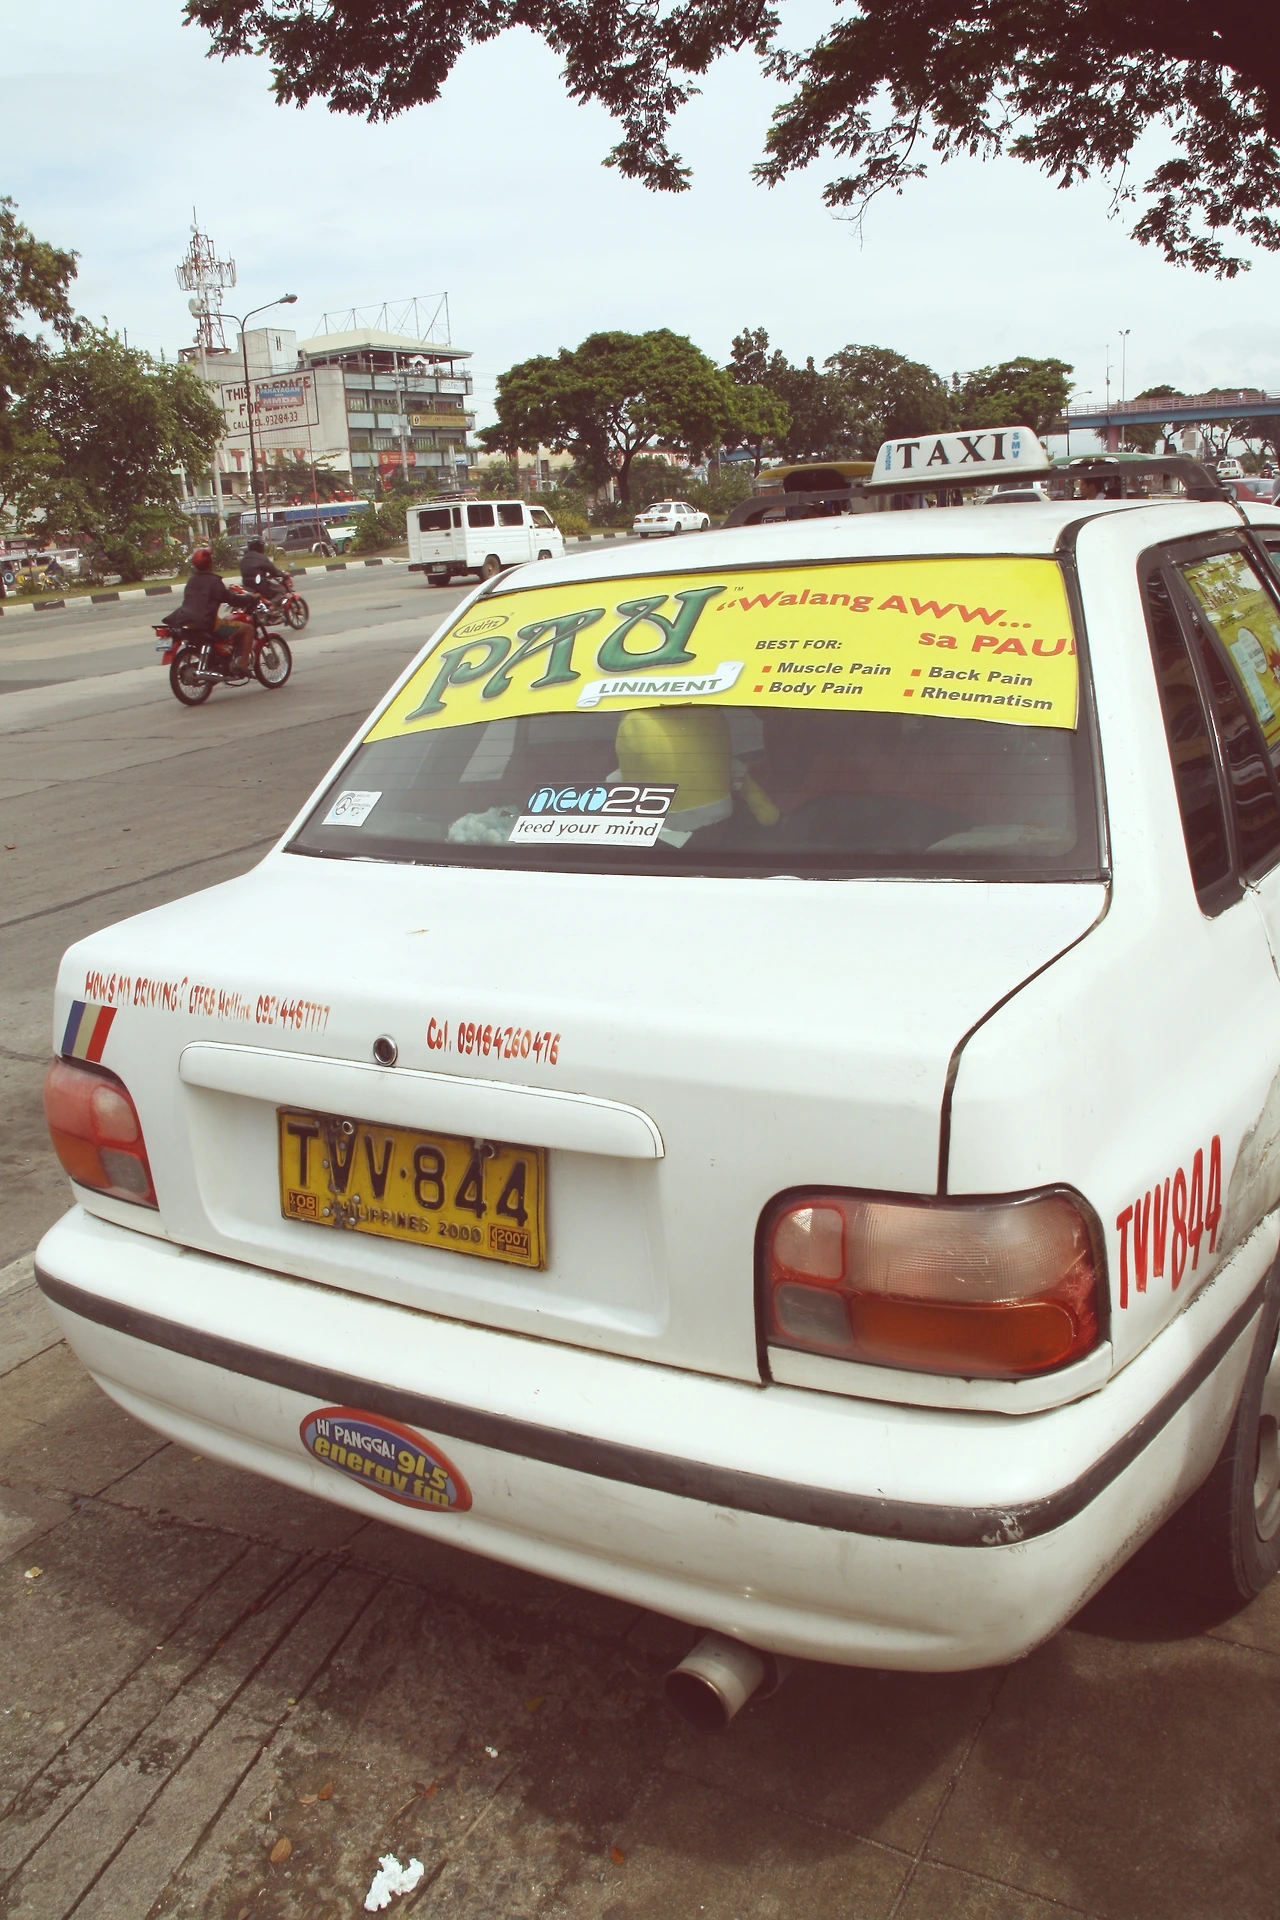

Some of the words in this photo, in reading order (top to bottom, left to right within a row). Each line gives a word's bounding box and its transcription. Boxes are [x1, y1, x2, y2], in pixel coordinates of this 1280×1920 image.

[226, 387, 250, 402] THIS
[263, 397, 299, 405] MMDA
[239, 401, 262, 417] FOR
[896, 432, 1008, 469] TAXI
[1011, 432, 1021, 459] SMV
[877, 595, 1032, 629] AWW...
[460, 619, 500, 636] Aldritz
[755, 640, 799, 650] BEST
[802, 639, 842, 650] FOR:
[918, 632, 958, 650] sa
[405, 586, 728, 721] PAU
[777, 662, 843, 674] Muscle
[849, 663, 892, 676] Pain
[928, 666, 981, 682] Back
[987, 671, 1033, 687] Pain
[599, 678, 722, 694] LINIMENT
[768, 682, 816, 696] Body
[821, 682, 863, 695] Pain
[920, 686, 1053, 711] Rheumatism
[527, 786, 675, 815] net25
[517, 820, 556, 834] feed
[556, 823, 601, 837] your
[604, 820, 659, 837] mind
[84, 970, 116, 1004] HOWS
[296, 1194, 316, 1210] 08
[437, 1219, 484, 1244] 2000
[1116, 1134, 1222, 1310] TVV844
[497, 1229, 528, 1247] 2007
[316, 1418, 330, 1437] HI
[334, 1425, 396, 1461] PANGGA!
[313, 1436, 408, 1492] energy
[412, 1480, 451, 1508] fm
[397, 1450, 449, 1490] 91.5
